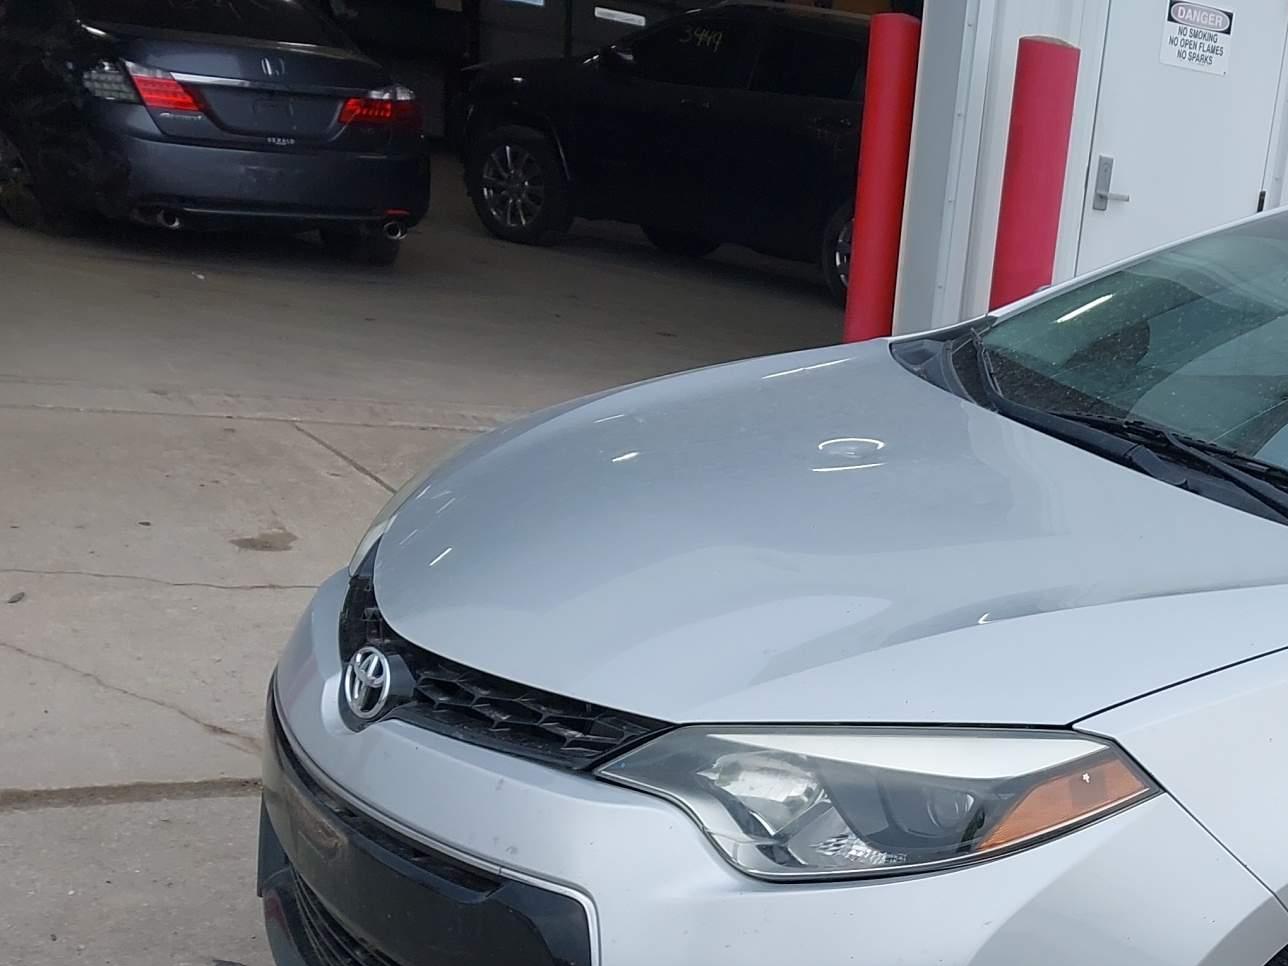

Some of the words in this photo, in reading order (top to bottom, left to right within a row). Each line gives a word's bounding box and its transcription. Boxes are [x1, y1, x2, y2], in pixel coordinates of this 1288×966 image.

[1177, 6, 1223, 27] DANGER
[1178, 26, 1188, 37] NO
[1189, 28, 1218, 44] SMOKING
[1169, 35, 1179, 47] NO
[1180, 38, 1198, 50] OPEN
[1199, 42, 1224, 56] FLAMES
[1177, 49, 1187, 60] NO
[1188, 51, 1213, 65] SPARKS
